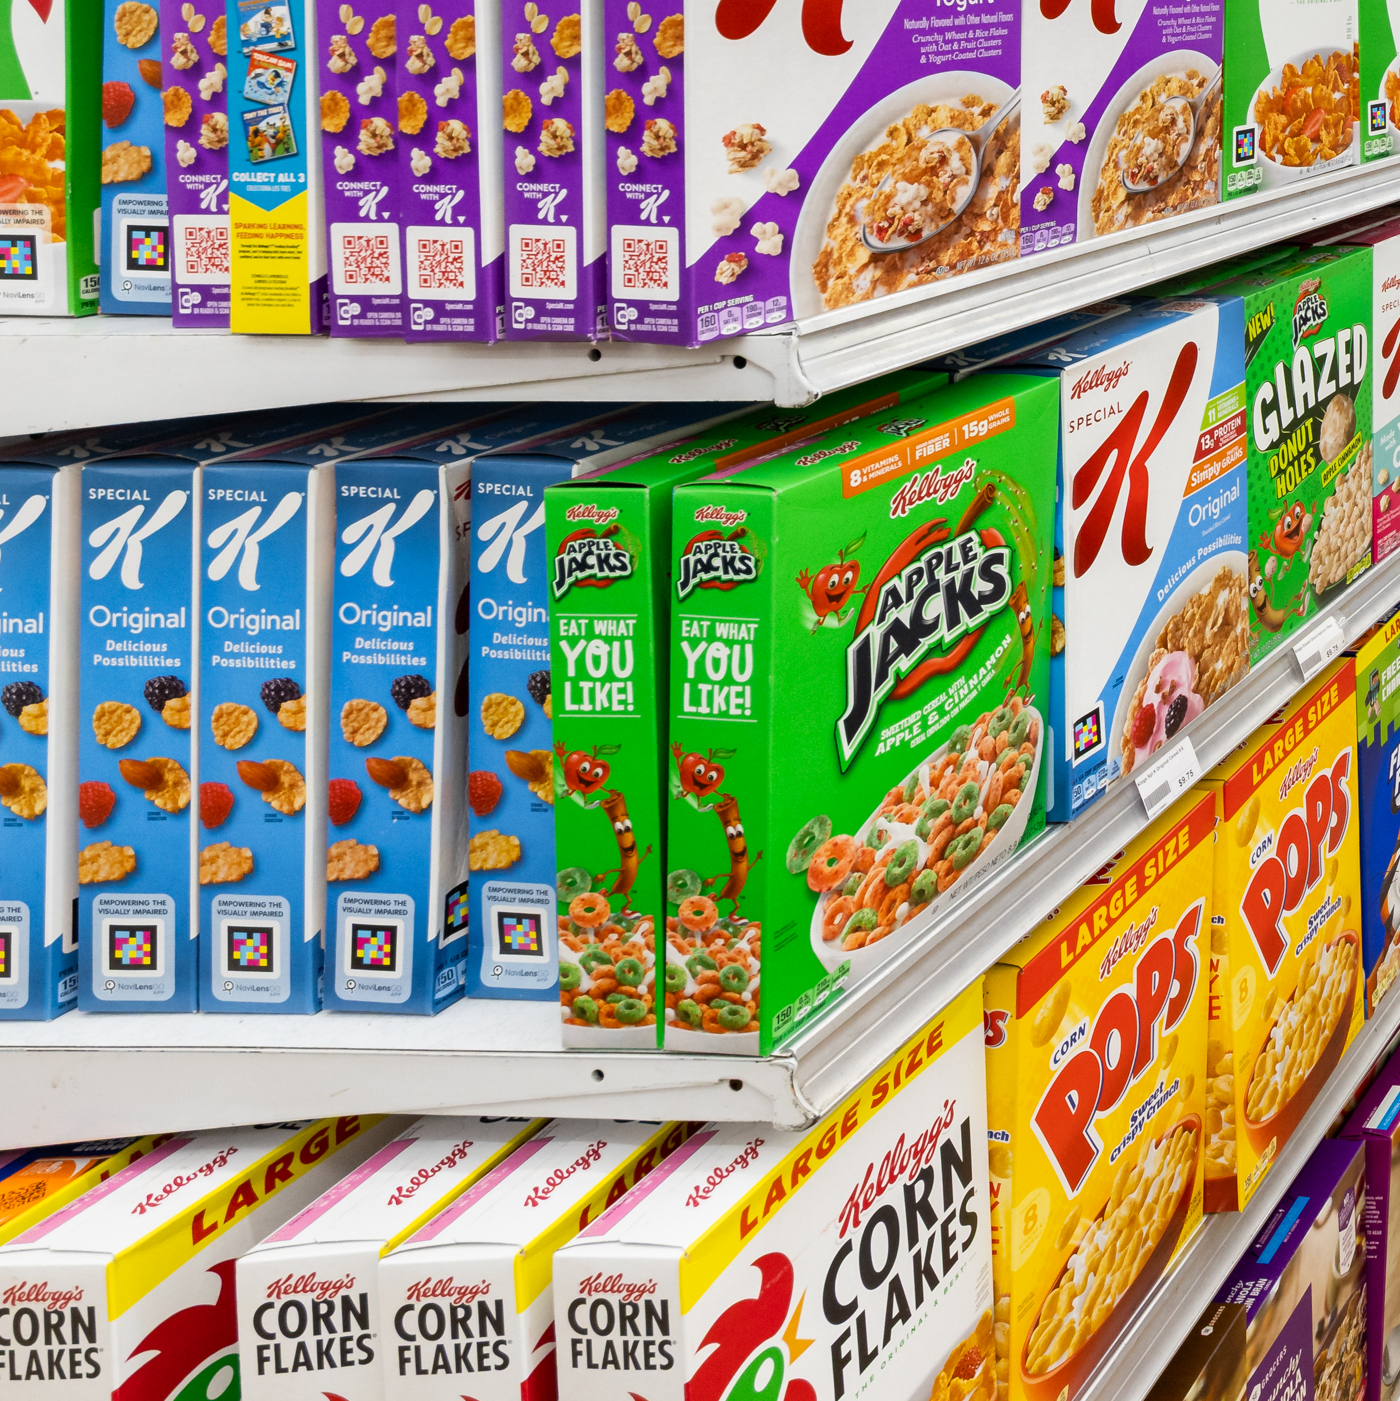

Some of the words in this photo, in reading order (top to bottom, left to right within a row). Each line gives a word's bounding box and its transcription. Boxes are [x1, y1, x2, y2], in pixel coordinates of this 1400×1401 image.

[232, 172, 275, 183] COLLECT
[278, 172, 296, 182] ALL
[336, 181, 382, 192] CONNECT
[1253, 323, 1368, 449] GLAZED
[1213, 415, 1243, 445] PROTEIN
[1270, 416, 1313, 479] DONUT
[1276, 447, 1315, 499] HOLES
[1323, 460, 1338, 482] APPLE
[1338, 435, 1362, 466] CINNAMON
[87, 487, 152, 501] SPECIAL
[889, 460, 977, 520] Kellogg's
[1187, 476, 1241, 527] Original
[879, 529, 982, 623] APPLE
[87, 604, 187, 634] Original
[558, 618, 590, 638] EAT
[593, 618, 638, 638] WHAT
[91, 655, 182, 669] Possibilities
[104, 640, 169, 654] Delicious
[559, 637, 635, 679] YOU
[836, 546, 1016, 775] JACKS
[1326, 644, 1340, 658] $9.75
[942, 633, 1014, 714] CINNAMON
[563, 678, 635, 713] LIKE!
[1252, 723, 1305, 787] LARGE
[1307, 682, 1340, 724] SIZE
[1178, 769, 1195, 788] $9.75
[97, 907, 131, 918] VISUALLY
[132, 907, 169, 918] IMPAIRED
[98, 897, 151, 908] EMPOWERING
[152, 898, 168, 907] THE
[1030, 897, 1208, 1201] POPS
[738, 1073, 867, 1242] LARGE
[867, 1017, 950, 1112] SIZE
[566, 1297, 670, 1338] CORN
[569, 1338, 675, 1373] FLAKES
